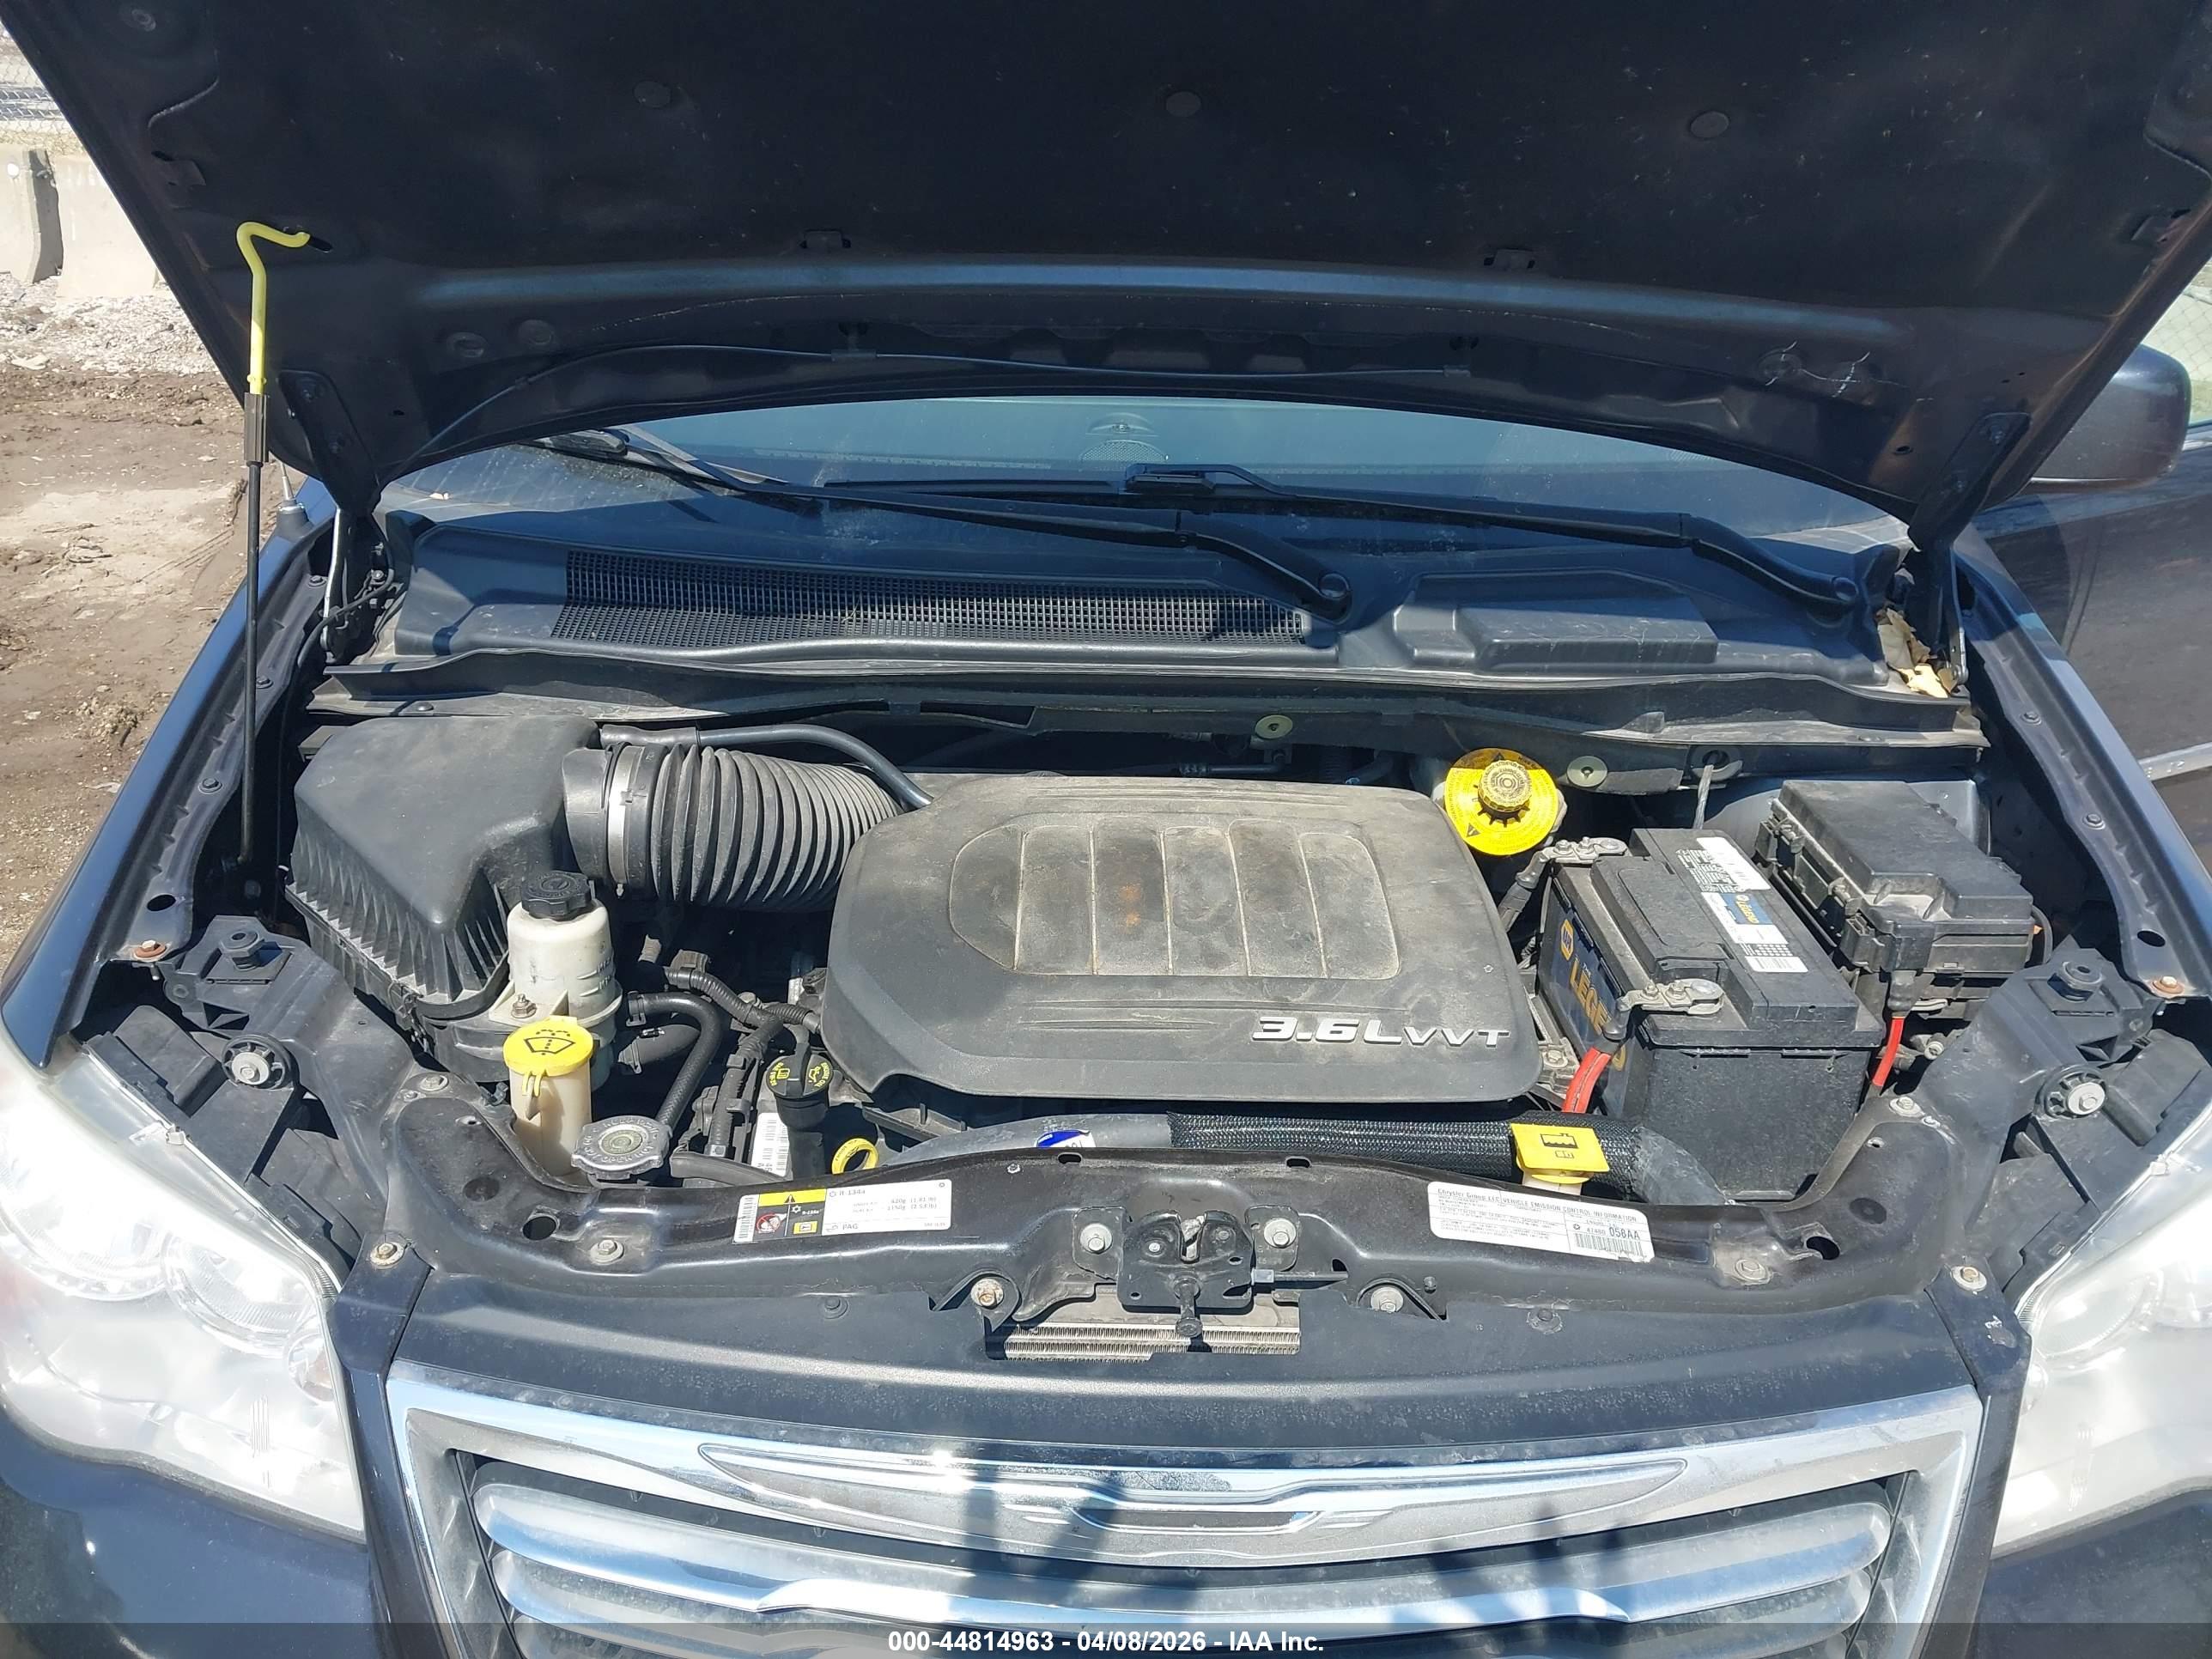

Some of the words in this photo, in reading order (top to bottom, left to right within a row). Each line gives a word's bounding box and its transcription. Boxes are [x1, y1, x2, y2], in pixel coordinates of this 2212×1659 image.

[1252, 1016, 1402, 1045] 3.6L
[1404, 1026, 1510, 1048] VVT
[821, 1062, 830, 1079] ENGINE
[1437, 1188, 1464, 1197] Chrysler
[1467, 1192, 1486, 1200] Group
[1503, 1197, 1528, 1206] VEHICLE
[1530, 1201, 1561, 1211] EMISSION
[1562, 1206, 1591, 1216] CONTROL
[1593, 1211, 1637, 1222] INFORMATION
